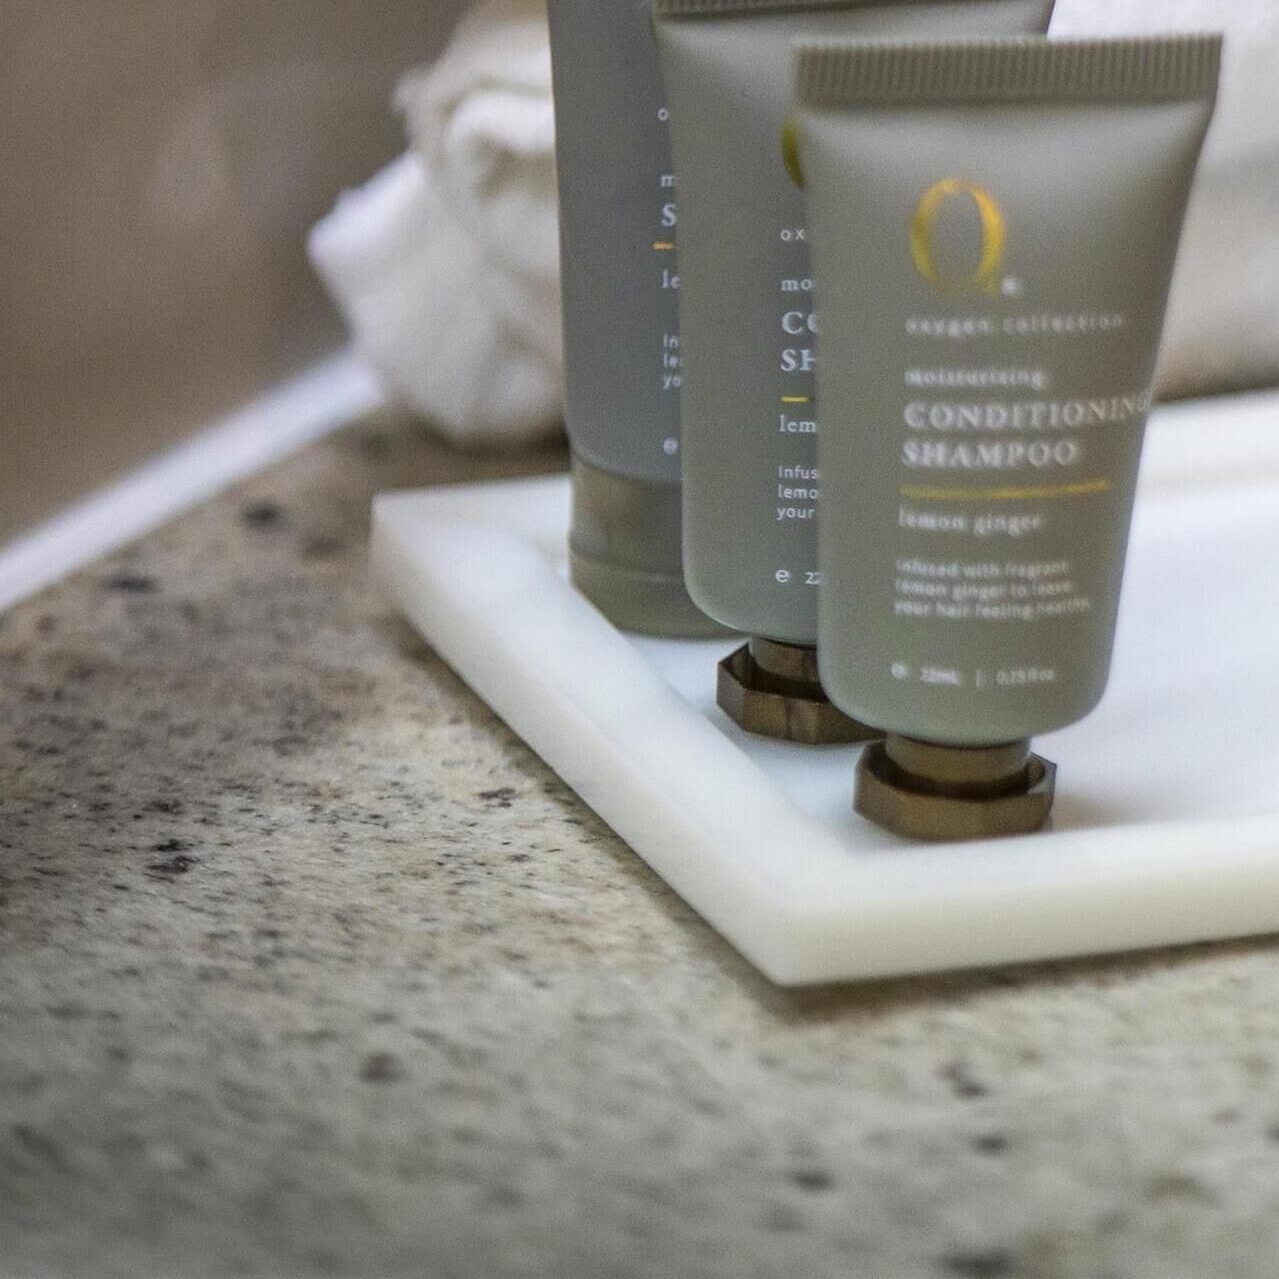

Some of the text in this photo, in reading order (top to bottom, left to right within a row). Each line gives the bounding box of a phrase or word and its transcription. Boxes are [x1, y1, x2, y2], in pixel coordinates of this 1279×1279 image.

[902, 439, 1078, 467] SHAMPOO
[777, 507, 815, 521] your
[899, 504, 1041, 536] lemon ginger
